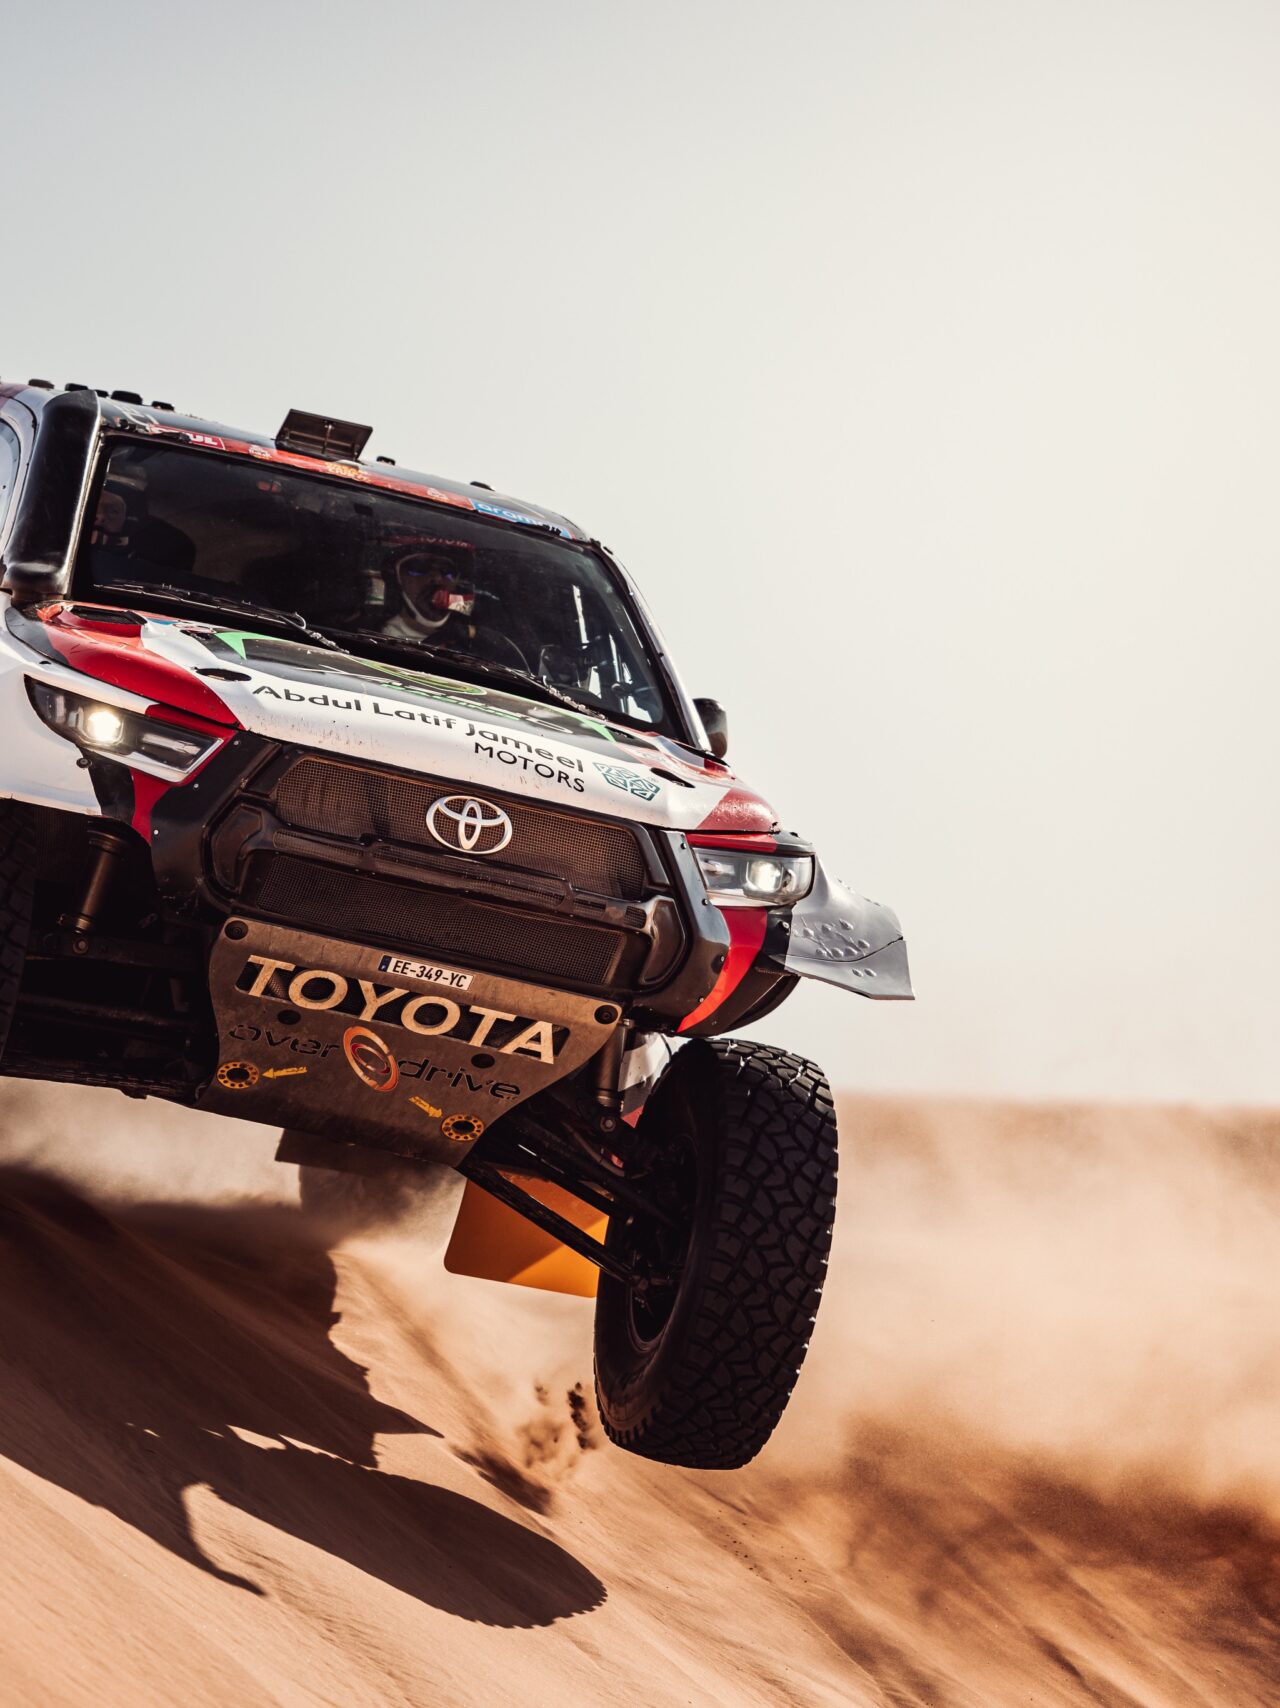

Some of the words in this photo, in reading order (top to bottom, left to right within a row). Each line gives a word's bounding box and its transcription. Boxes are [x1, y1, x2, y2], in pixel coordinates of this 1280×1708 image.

[253, 685, 362, 711] Abdul
[373, 702, 456, 729] Latif
[465, 723, 584, 773] Jameel
[474, 742, 585, 793] MOTORS
[392, 960, 467, 988] EE-349-YC
[247, 954, 554, 1064] TOYOTA
